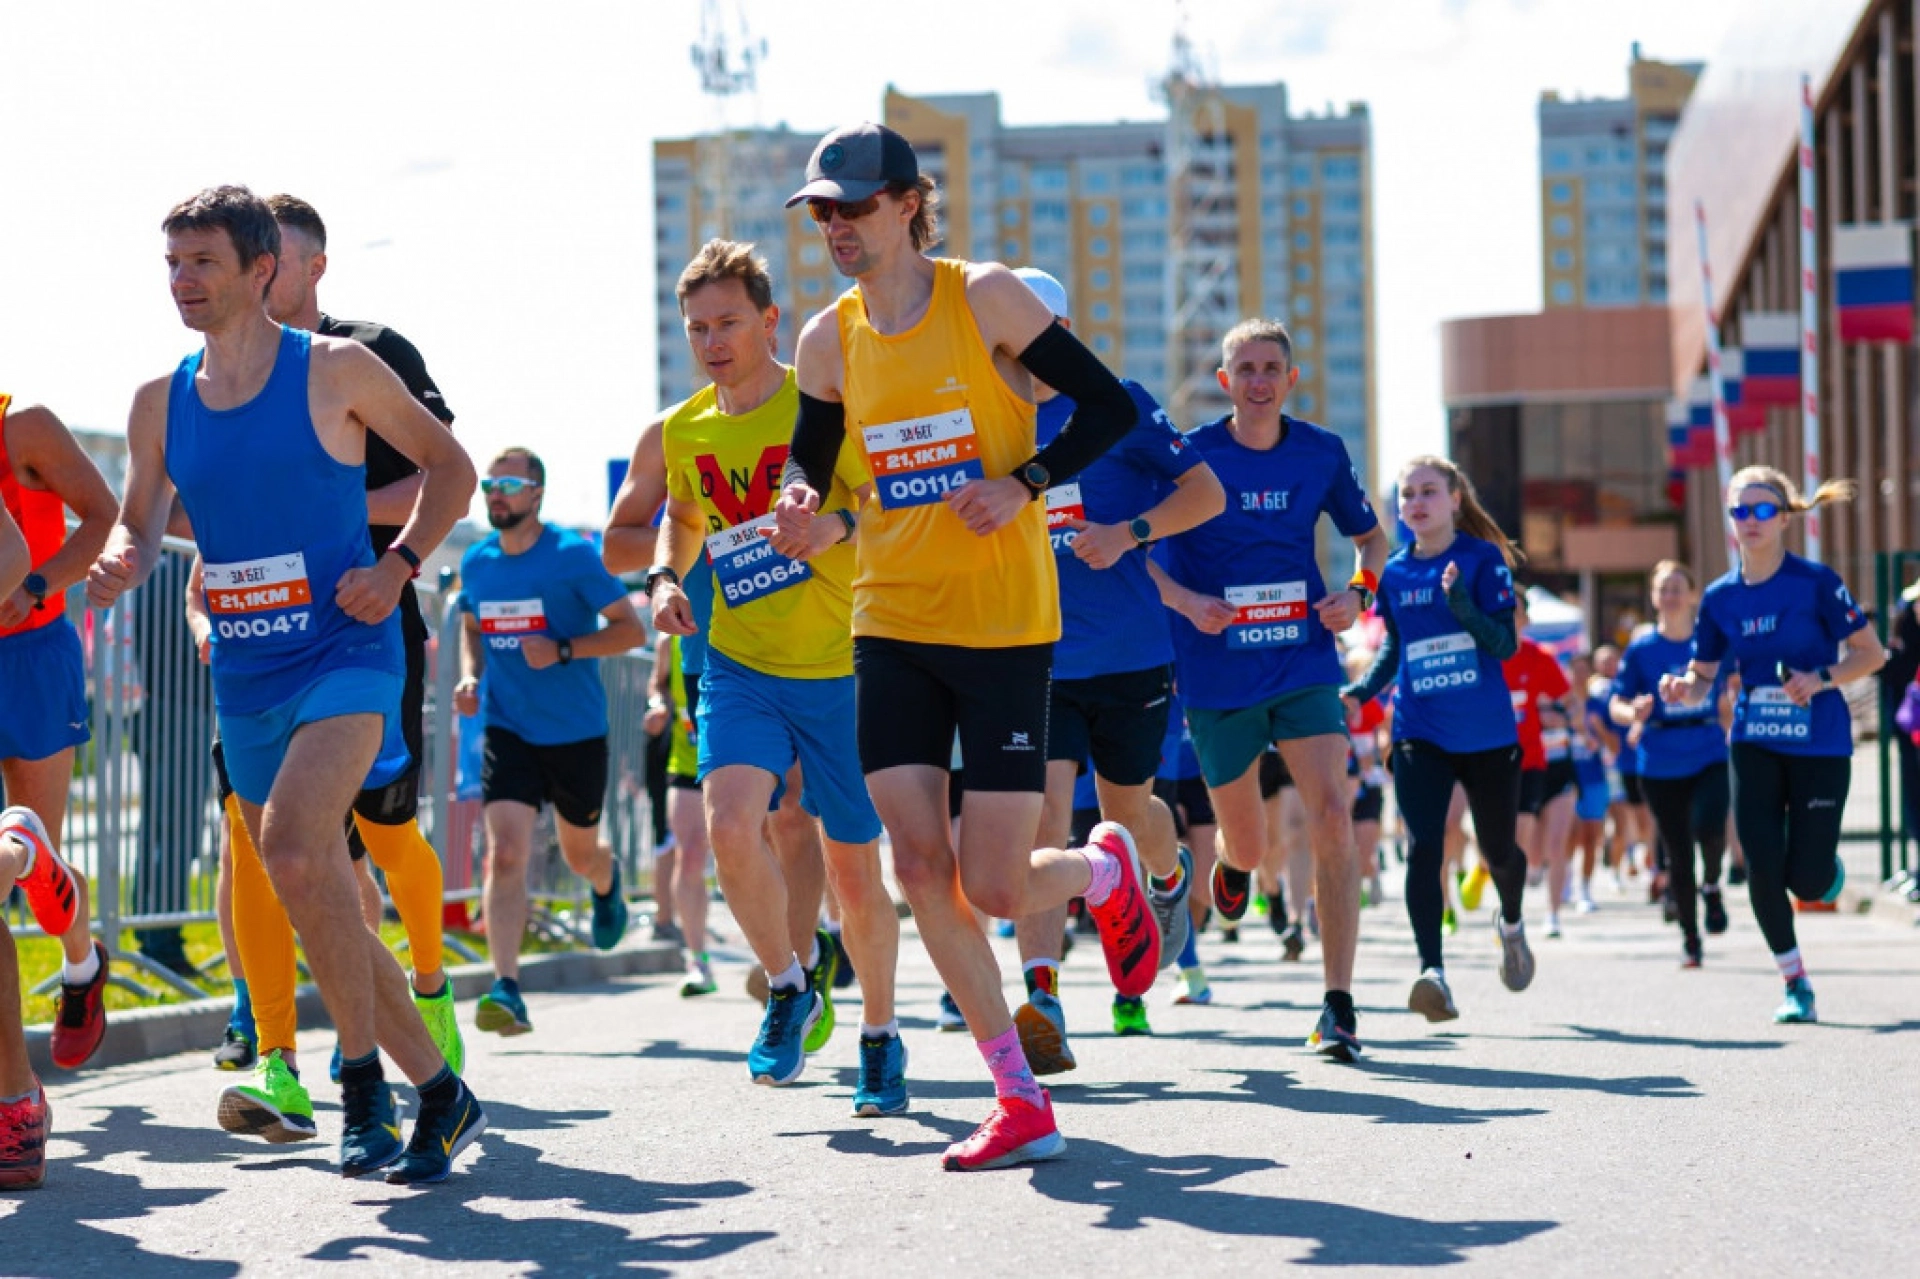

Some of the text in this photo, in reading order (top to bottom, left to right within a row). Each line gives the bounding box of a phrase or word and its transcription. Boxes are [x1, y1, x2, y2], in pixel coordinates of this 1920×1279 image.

[890, 470, 967, 499] 00114
[725, 559, 806, 601] 50064
[218, 611, 310, 639] 00047
[1239, 624, 1300, 644] 10138
[489, 635, 520, 650] 100
